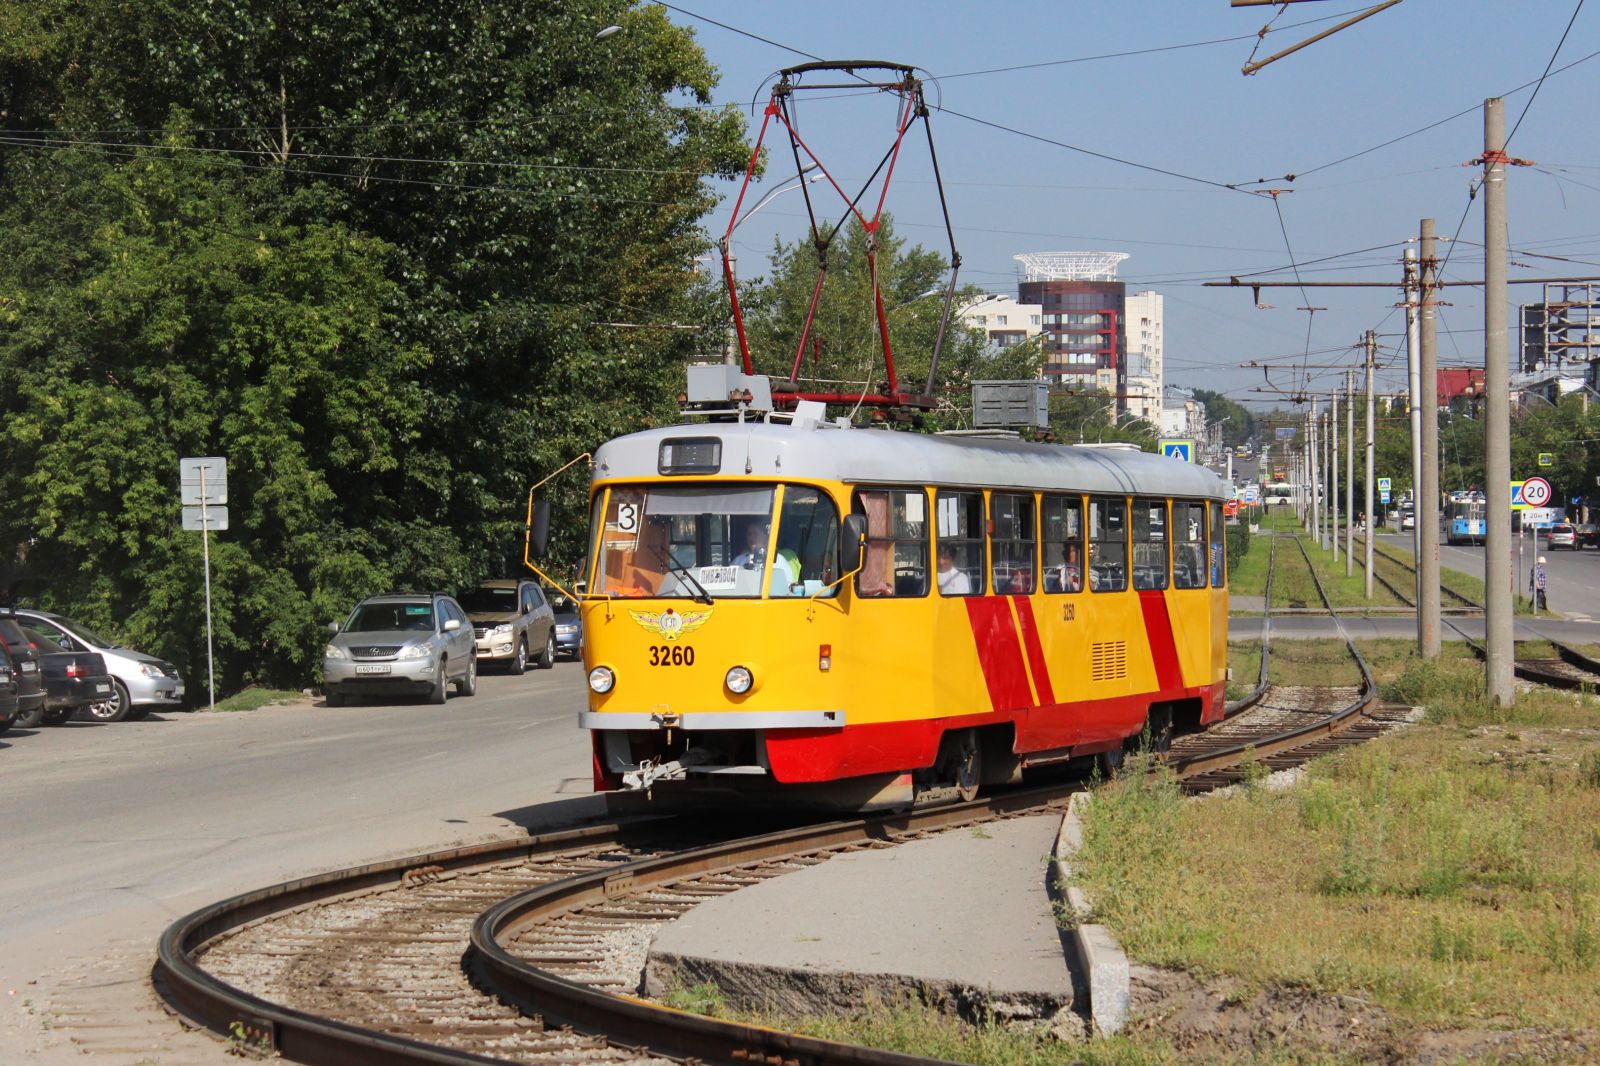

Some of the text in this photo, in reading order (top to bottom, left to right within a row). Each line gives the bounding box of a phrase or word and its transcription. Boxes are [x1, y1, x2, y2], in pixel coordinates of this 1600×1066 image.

[1528, 487, 1545, 498] 20
[619, 506, 635, 530] 3
[1063, 603, 1075, 621] 3260
[649, 645, 695, 667] 3260
